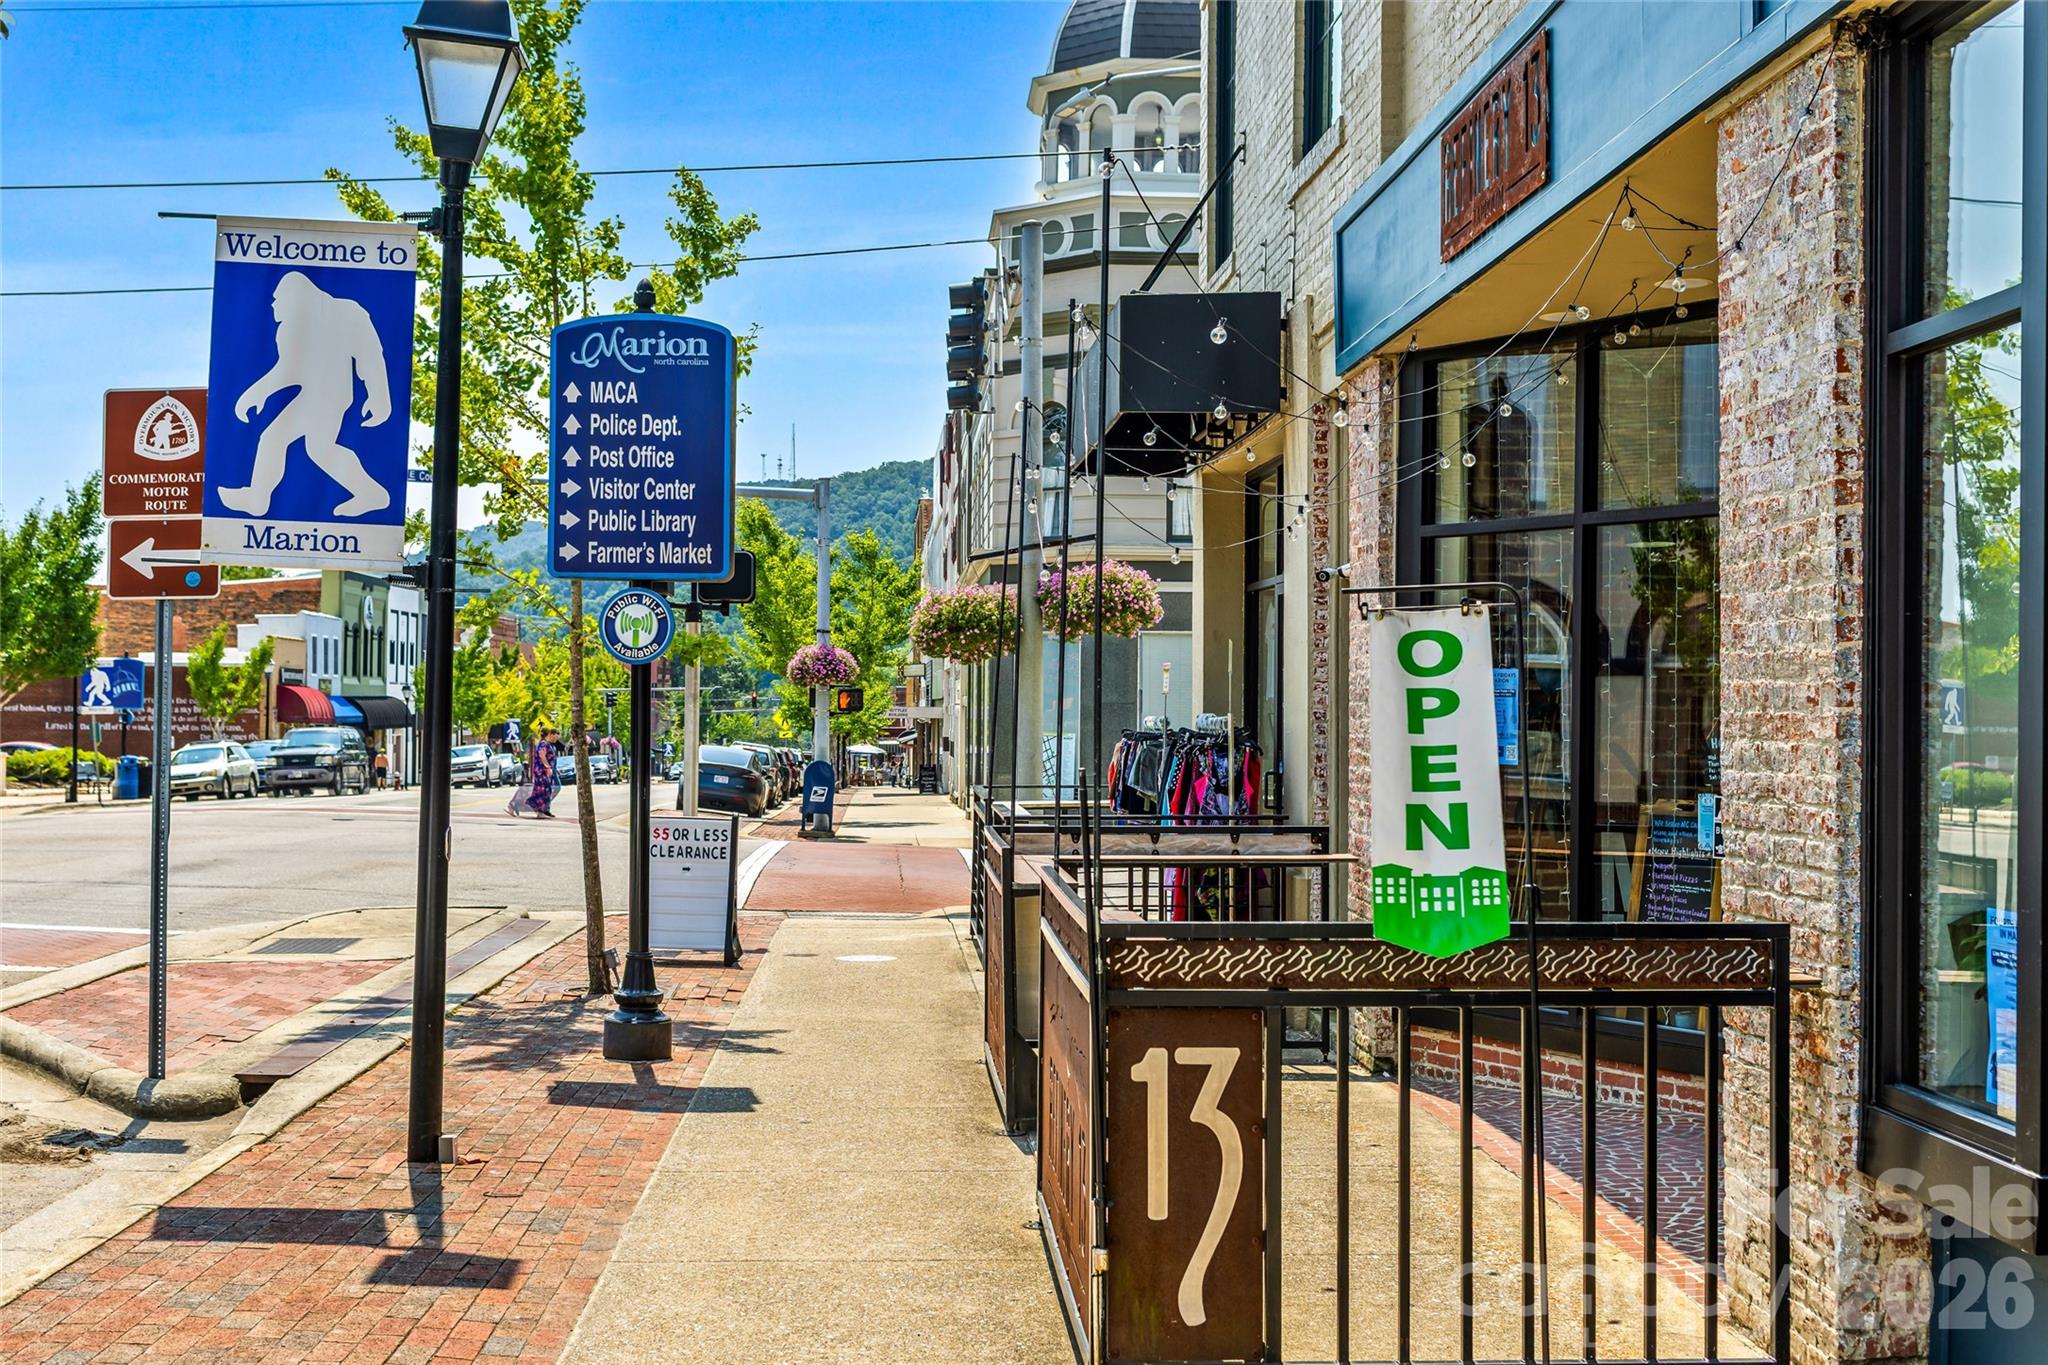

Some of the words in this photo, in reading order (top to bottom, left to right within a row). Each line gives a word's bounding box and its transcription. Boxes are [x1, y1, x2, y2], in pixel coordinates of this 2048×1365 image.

[1522, 48, 1541, 152] 13
[223, 231, 366, 263] Welcome
[377, 240, 408, 265] to
[571, 326, 709, 373] Marion
[590, 381, 638, 404] MACA
[139, 402, 178, 445] OVERMOUNTAIN
[181, 411, 195, 443] VICTORY
[590, 413, 637, 436] Police
[641, 415, 682, 441] Dept.
[590, 445, 625, 468] Post
[629, 445, 674, 468] Office
[409, 470, 415, 478] E
[143, 486, 189, 497] MOTOR
[589, 477, 640, 500] Visitor
[644, 478, 695, 501] Center
[145, 500, 187, 511] ROUTE
[588, 509, 637, 532] Public
[642, 510, 696, 538] Library
[243, 523, 361, 555] Marion
[588, 540, 655, 564] Farmer's
[660, 542, 712, 565] Market
[607, 594, 638, 620] Public
[641, 594, 665, 619] Wi-Fi
[613, 640, 660, 658] Available
[1397, 629, 1470, 851] OPEN
[653, 827, 670, 840] $5
[673, 828, 689, 841] OR
[694, 828, 728, 842] LESS
[650, 845, 727, 860] CLEARANCE
[1671, 847, 1705, 860] Highlights
[1130, 1047, 1243, 1327] 13
